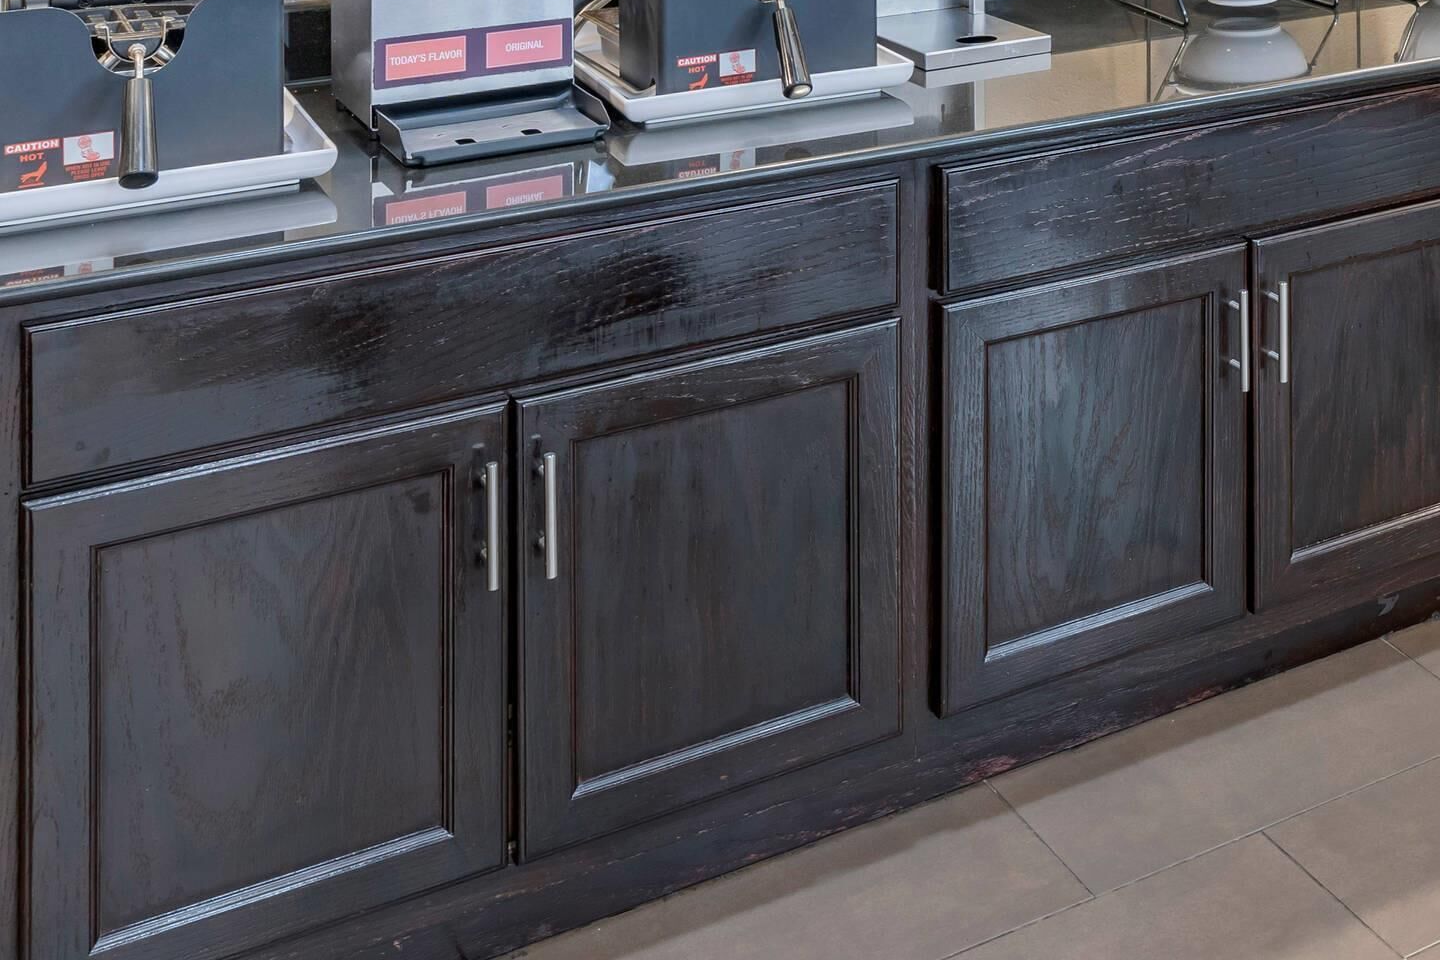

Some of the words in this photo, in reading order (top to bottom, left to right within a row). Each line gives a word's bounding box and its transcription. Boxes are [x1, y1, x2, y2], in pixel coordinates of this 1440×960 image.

[505, 40, 545, 53] ORIGINAL
[390, 53, 427, 66] TODAY'S
[428, 49, 464, 62] FLAVOR
[678, 55, 717, 66] CAUTION
[6, 139, 59, 154] CAUTION
[20, 152, 44, 162] HOT
